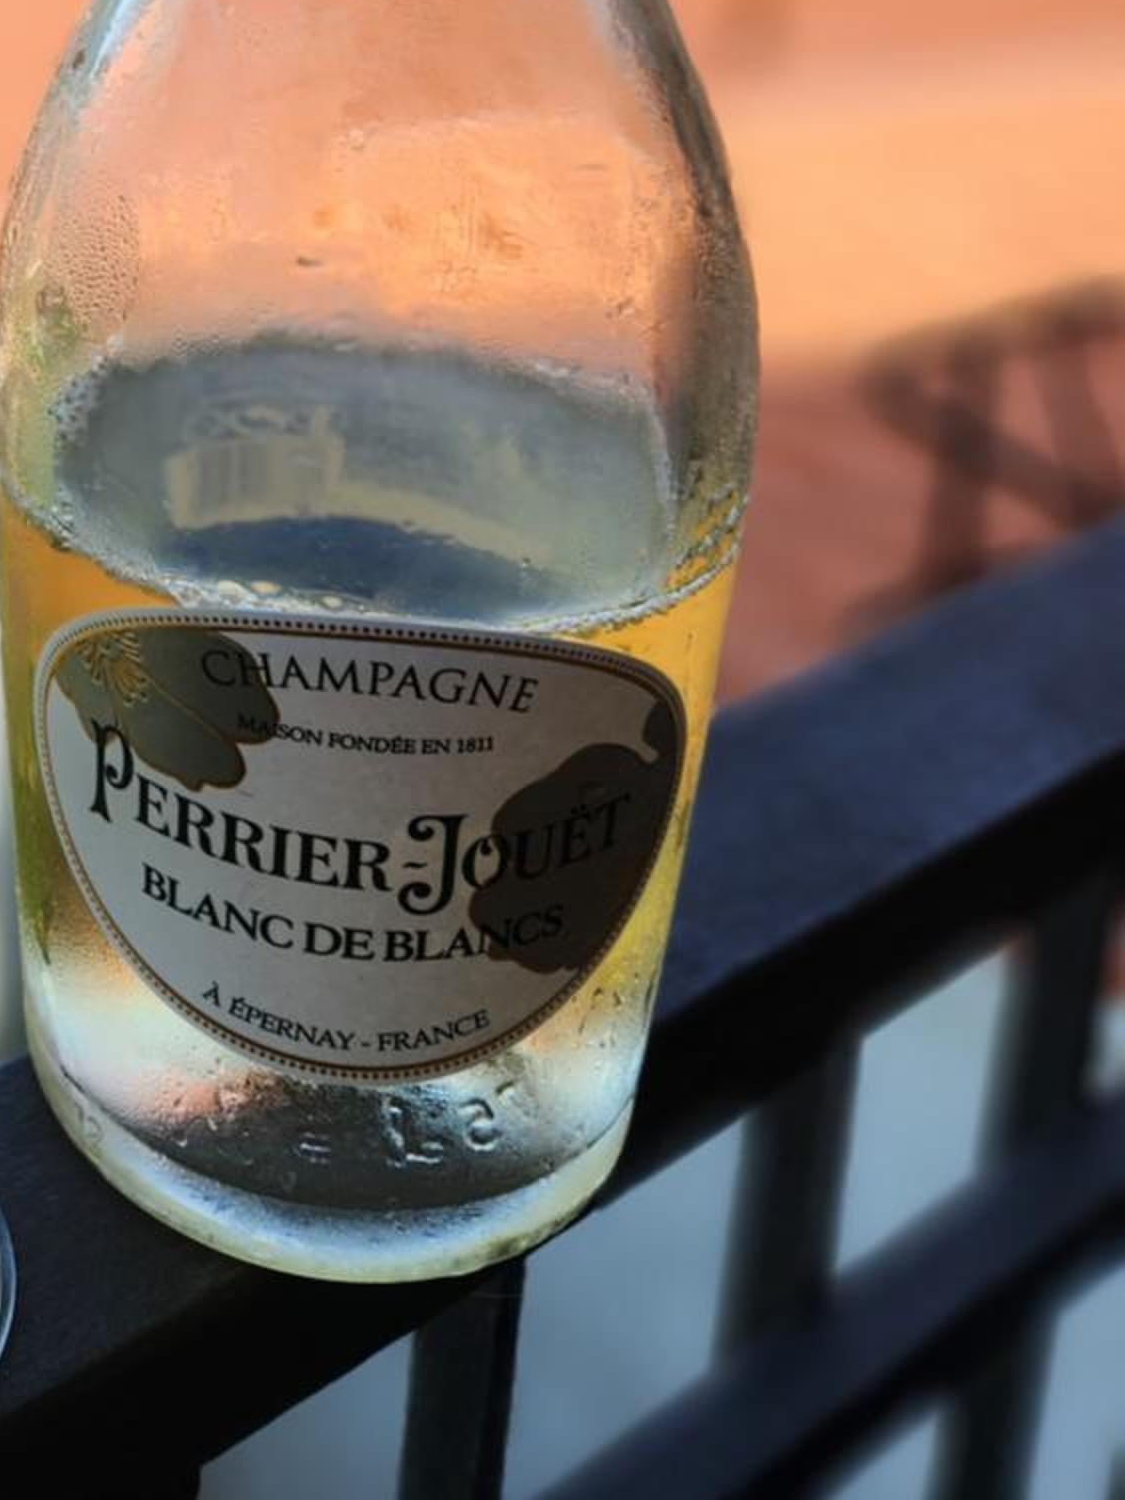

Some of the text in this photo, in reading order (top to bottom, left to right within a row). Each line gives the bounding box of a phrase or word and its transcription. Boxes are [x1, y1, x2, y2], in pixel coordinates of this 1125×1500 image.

[201, 649, 540, 714] CHAMPAGNE
[236, 713, 495, 755] MAISON FONDÉE EN 1811
[141, 862, 565, 962] BLANC DE BLANCS
[202, 980, 221, 1007] À
[228, 997, 357, 1051] ÉPERNAY
[378, 1009, 491, 1052] FRANCE
